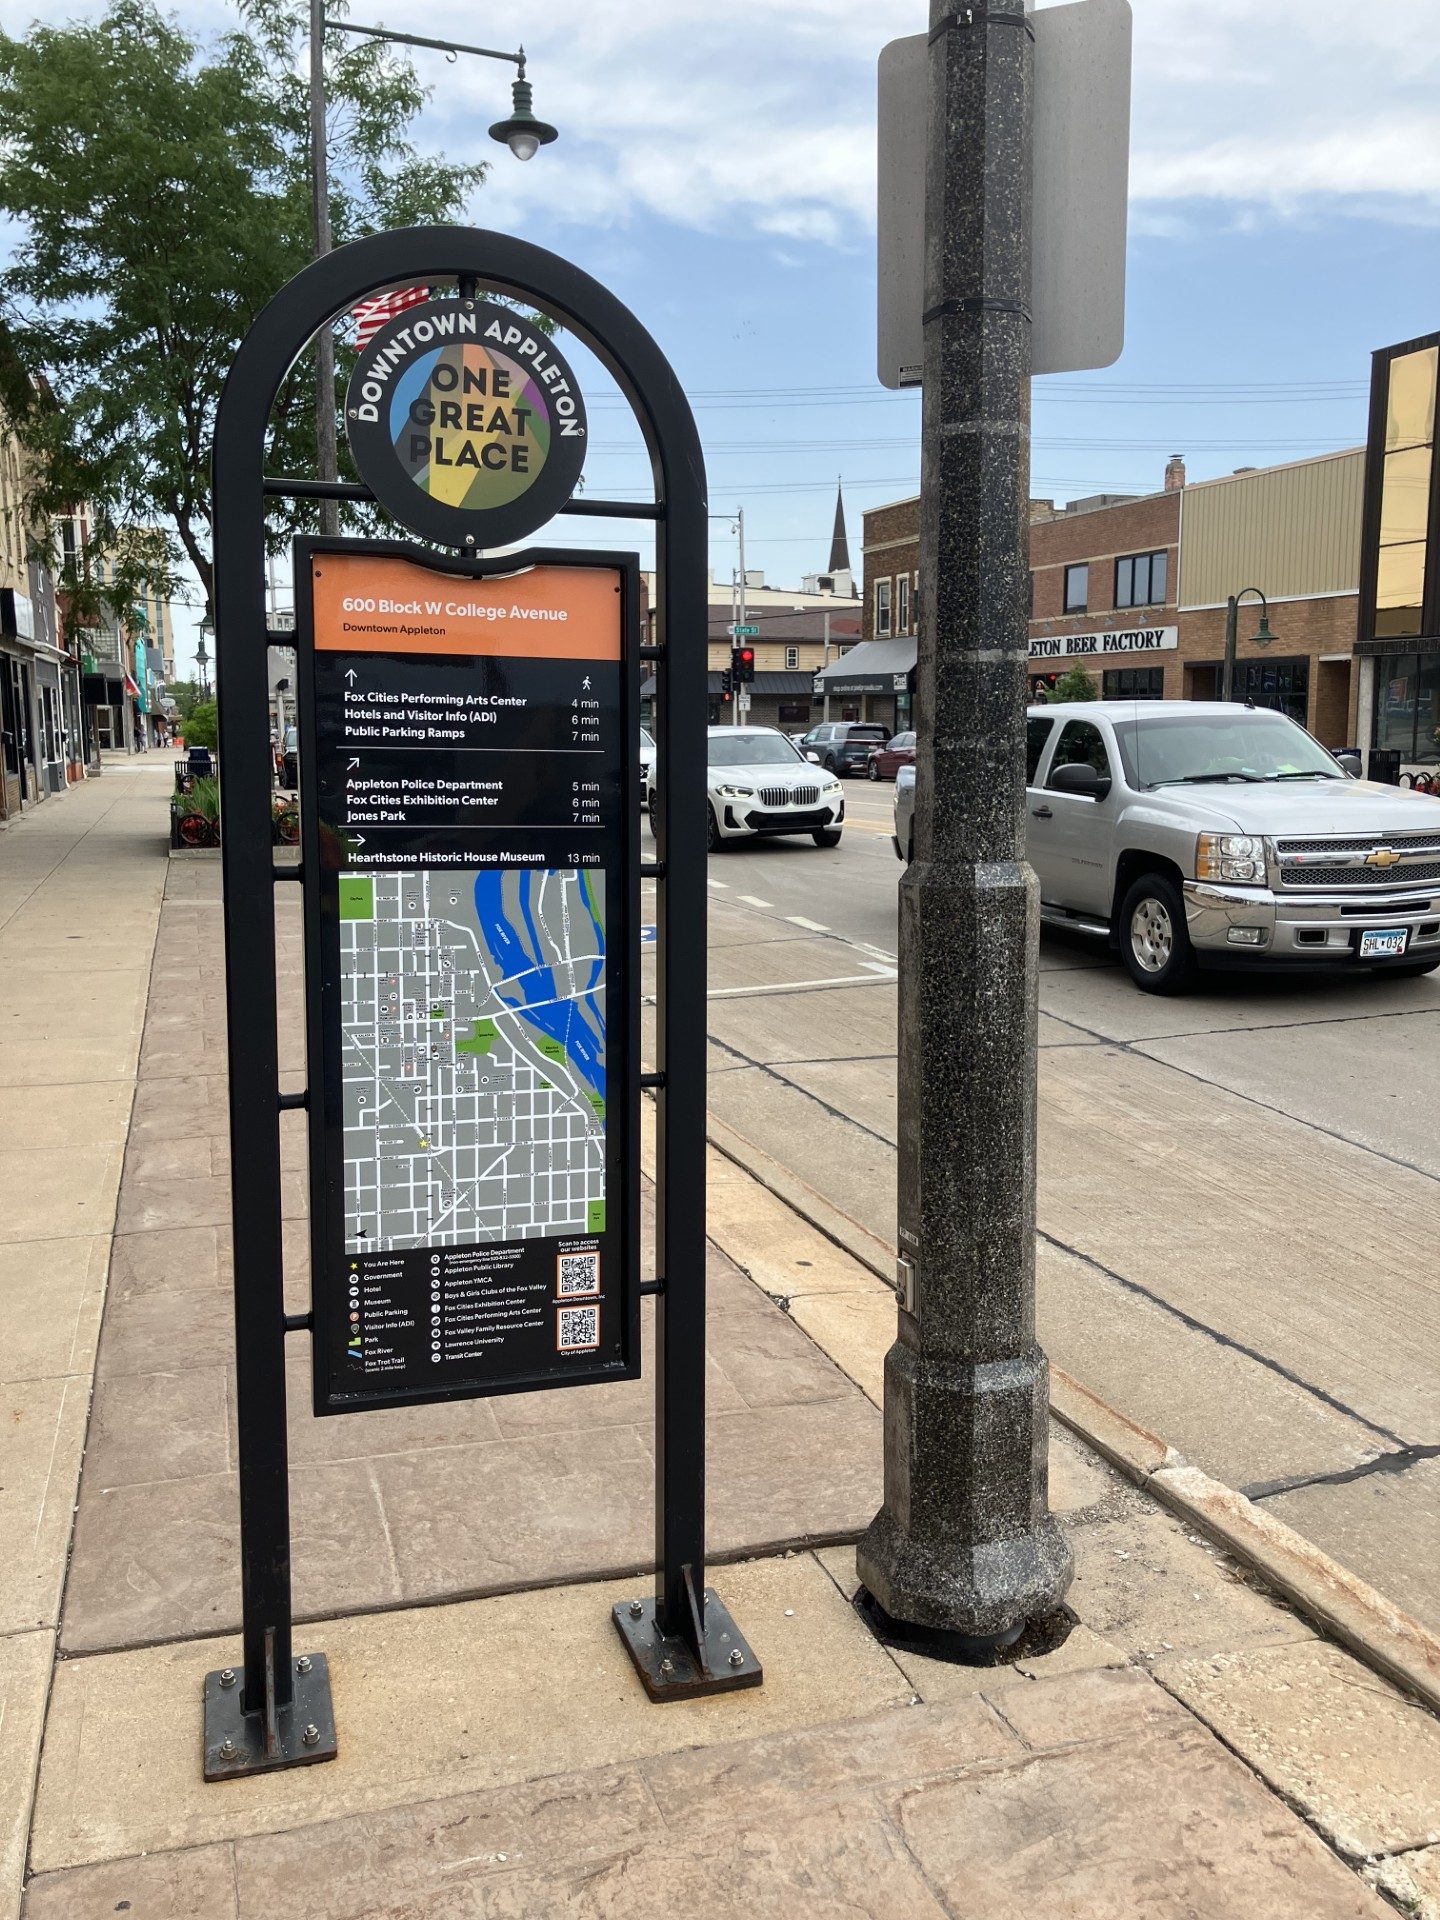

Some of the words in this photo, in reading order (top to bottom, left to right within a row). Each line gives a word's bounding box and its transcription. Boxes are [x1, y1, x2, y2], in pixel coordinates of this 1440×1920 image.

[358, 312, 476, 422] DOWNTOWN
[484, 320, 578, 437] APPLETON
[431, 363, 510, 398] ONE
[409, 398, 531, 437] GREAT
[410, 435, 529, 474] PLACE
[342, 598, 376, 612] 600
[378, 599, 422, 614] Block
[425, 602, 442, 615] W
[445, 602, 506, 621] College
[510, 605, 568, 620] Avenue
[343, 623, 398, 633] Downtown
[399, 625, 446, 635] Appleton
[1029, 639, 1061, 656] ETON
[1066, 636, 1098, 654] BEER
[1102, 630, 1164, 651] FACTORY
[344, 692, 365, 702] Fox
[367, 692, 399, 703] Cities
[401, 693, 463, 706] Performing
[466, 695, 488, 705] Arts
[490, 696, 527, 706] Center
[571, 699, 578, 708] 4
[581, 699, 599, 708] min
[345, 709, 381, 719] Hotels
[383, 710, 405, 720] and
[407, 710, 444, 720] Visitor
[446, 711, 467, 721] Info
[469, 711, 497, 723] (ADI)
[571, 715, 578, 725] 6
[581, 715, 599, 725] min
[345, 726, 380, 736] Public
[382, 726, 425, 739] Parking
[428, 728, 465, 740] Ramps
[571, 732, 578, 741] 7
[581, 732, 599, 741] min
[346, 779, 399, 790] Appleton
[401, 779, 435, 790] Police
[437, 780, 503, 791] Department
[572, 782, 579, 791] 5
[582, 782, 600, 791] min
[346, 795, 368, 805] Fox
[369, 795, 401, 805] Cities
[403, 795, 460, 805] Exhibition
[461, 796, 498, 805] Center
[572, 798, 579, 808] 6
[582, 798, 600, 807] min
[346, 811, 378, 823] Jones
[380, 811, 406, 820] Park
[572, 813, 579, 822] 7
[582, 813, 600, 822] min
[348, 852, 418, 863] Hearthstone
[419, 852, 462, 863] Historic
[463, 852, 498, 862] House
[500, 852, 545, 862] Museum
[567, 853, 579, 863] 13
[582, 853, 600, 863] min
[500, 930, 511, 945] RIVER
[1364, 938, 1379, 951] SHL
[1386, 936, 1403, 948] 032
[580, 1048, 590, 1061] RIVER
[490, 1248, 525, 1256] Department
[364, 1272, 403, 1281] Government
[384, 1309, 408, 1317] Parking
[475, 1312, 508, 1320] Performing
[475, 1337, 504, 1345] University
